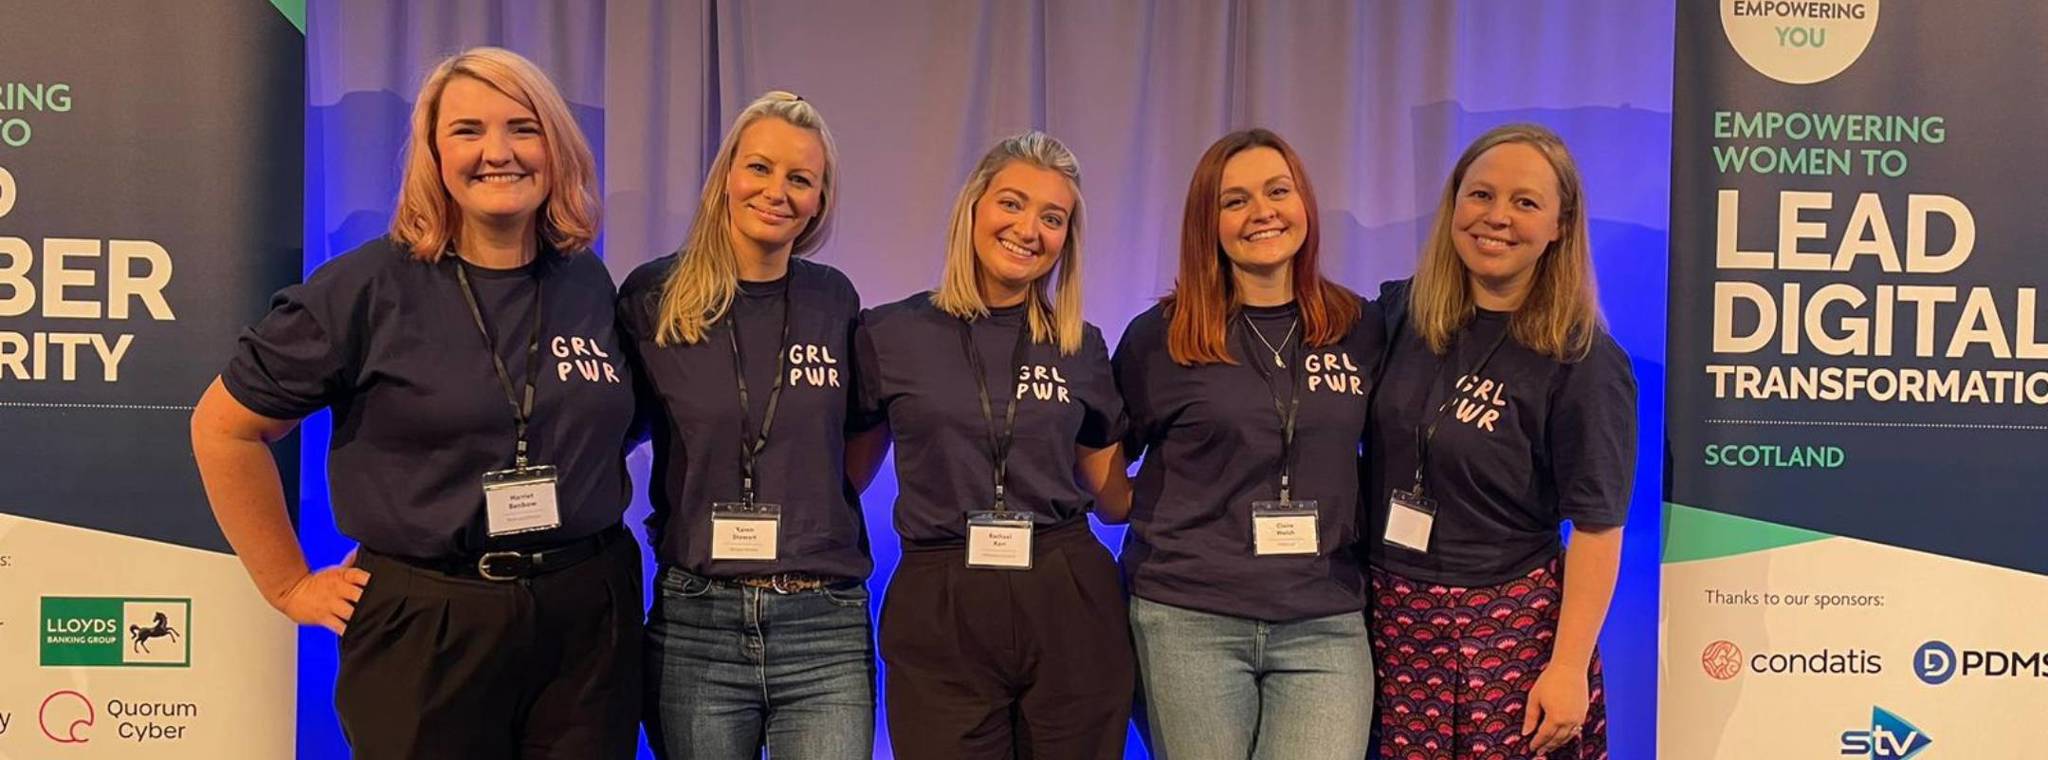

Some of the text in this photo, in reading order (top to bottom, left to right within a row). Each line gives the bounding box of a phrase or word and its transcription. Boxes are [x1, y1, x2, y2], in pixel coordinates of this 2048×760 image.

[1733, 1, 1866, 20] EMPOWERING
[1775, 26, 1826, 48] YOU
[1714, 111, 1945, 144] EMPOWERING
[1712, 147, 1908, 177] WOMEN TO
[1716, 189, 1976, 273] LEAD
[1713, 281, 2048, 359] DIGITAL
[551, 336, 609, 358] GRL
[789, 344, 837, 365] GRL
[557, 360, 621, 384] PWR
[1305, 353, 1358, 373] GRL
[789, 367, 840, 388] PWR
[1308, 373, 1364, 396] PWR
[1706, 366, 2048, 405] TRANSFORMATIO
[1016, 382, 1071, 404] PWR
[1704, 444, 1845, 468] SCOTLAND
[1705, 590, 1885, 610] Thanks to our sponsors:
[47, 618, 117, 633] LLOYDS
[47, 636, 86, 644] BANKING
[1751, 649, 1882, 675] condatis
[1962, 650, 2048, 678] PDM
[107, 699, 197, 718] Quorum
[118, 722, 186, 741] Cyber
[1841, 724, 1918, 756] stv
